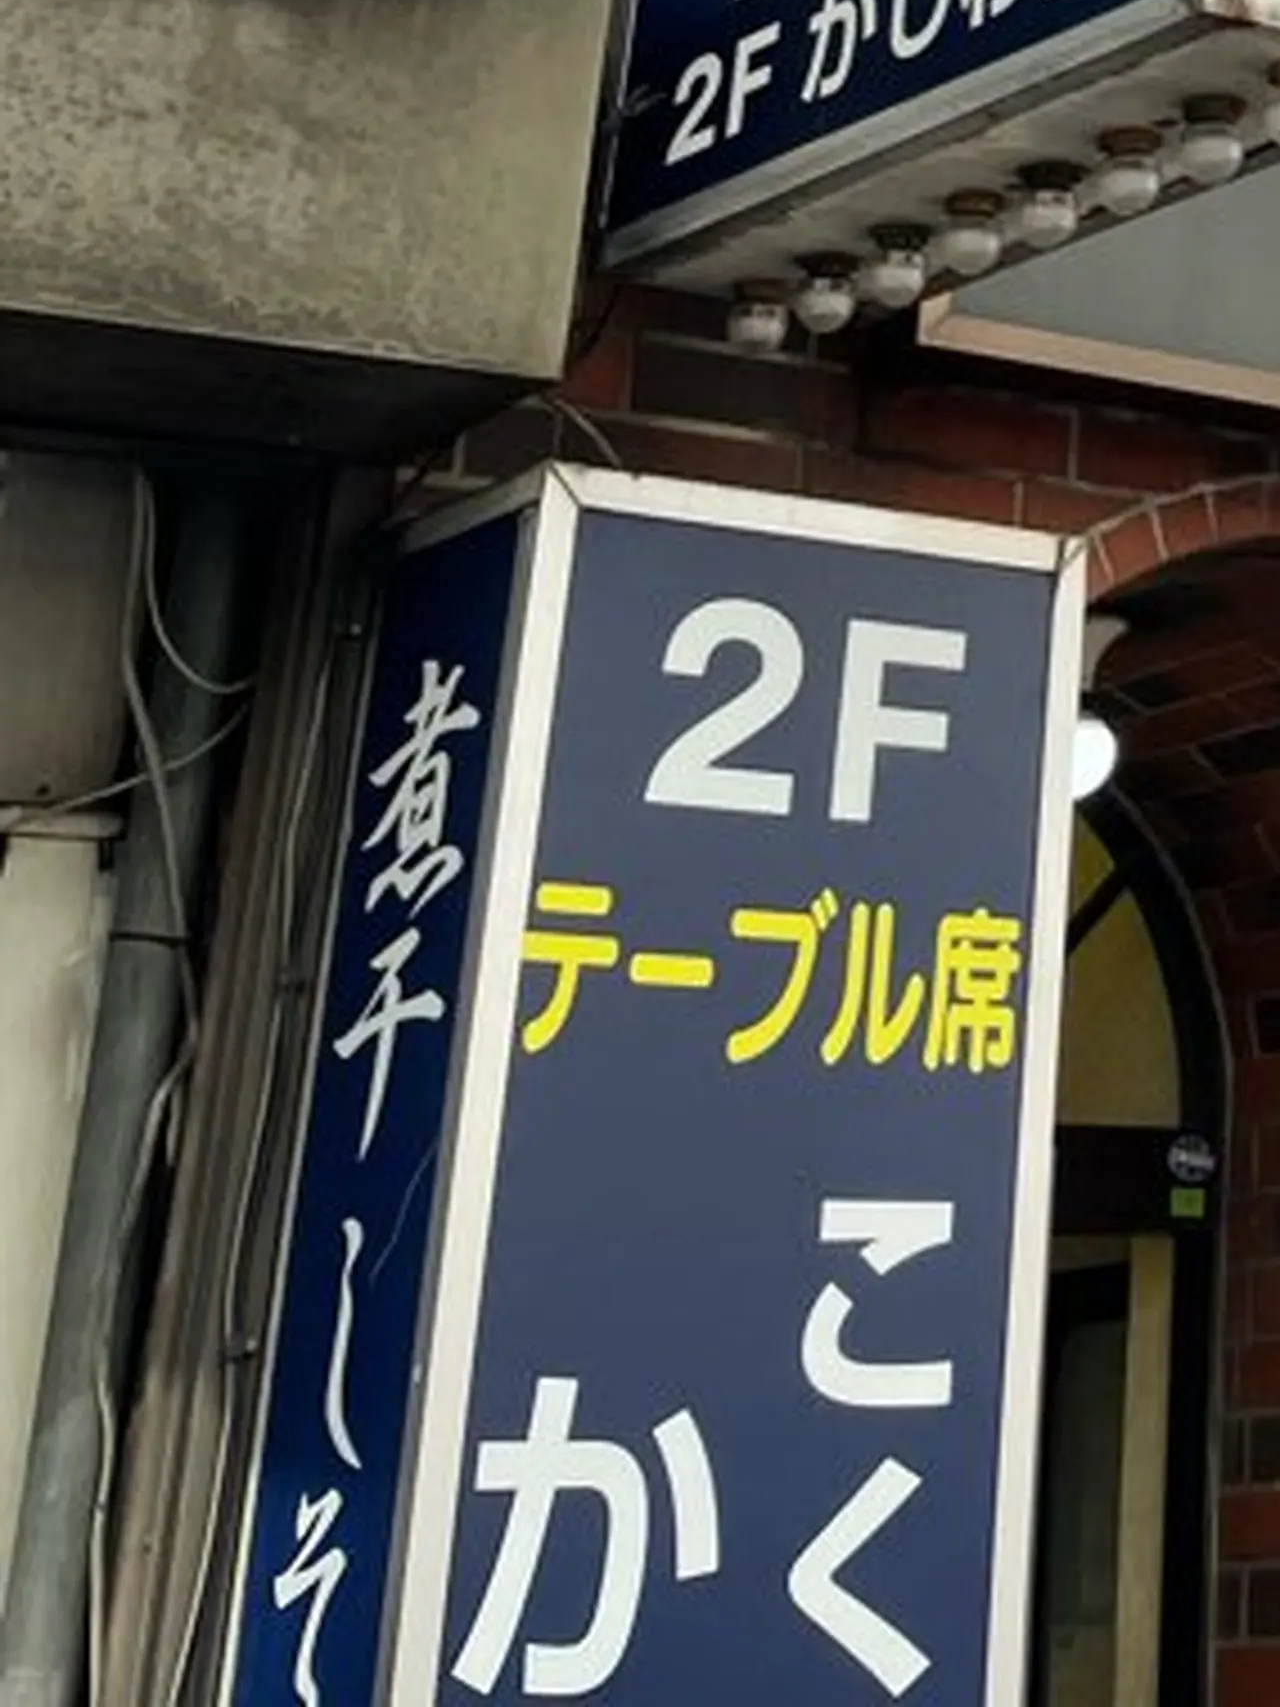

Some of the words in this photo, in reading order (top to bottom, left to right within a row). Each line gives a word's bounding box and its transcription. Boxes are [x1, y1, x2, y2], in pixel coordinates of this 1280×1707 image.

[664, 20, 782, 167] 2F
[643, 597, 967, 822] 2F
[518, 880, 1024, 1073] テーブル席
[449, 1375, 721, 1699] か
[786, 1197, 956, 1701] こく
